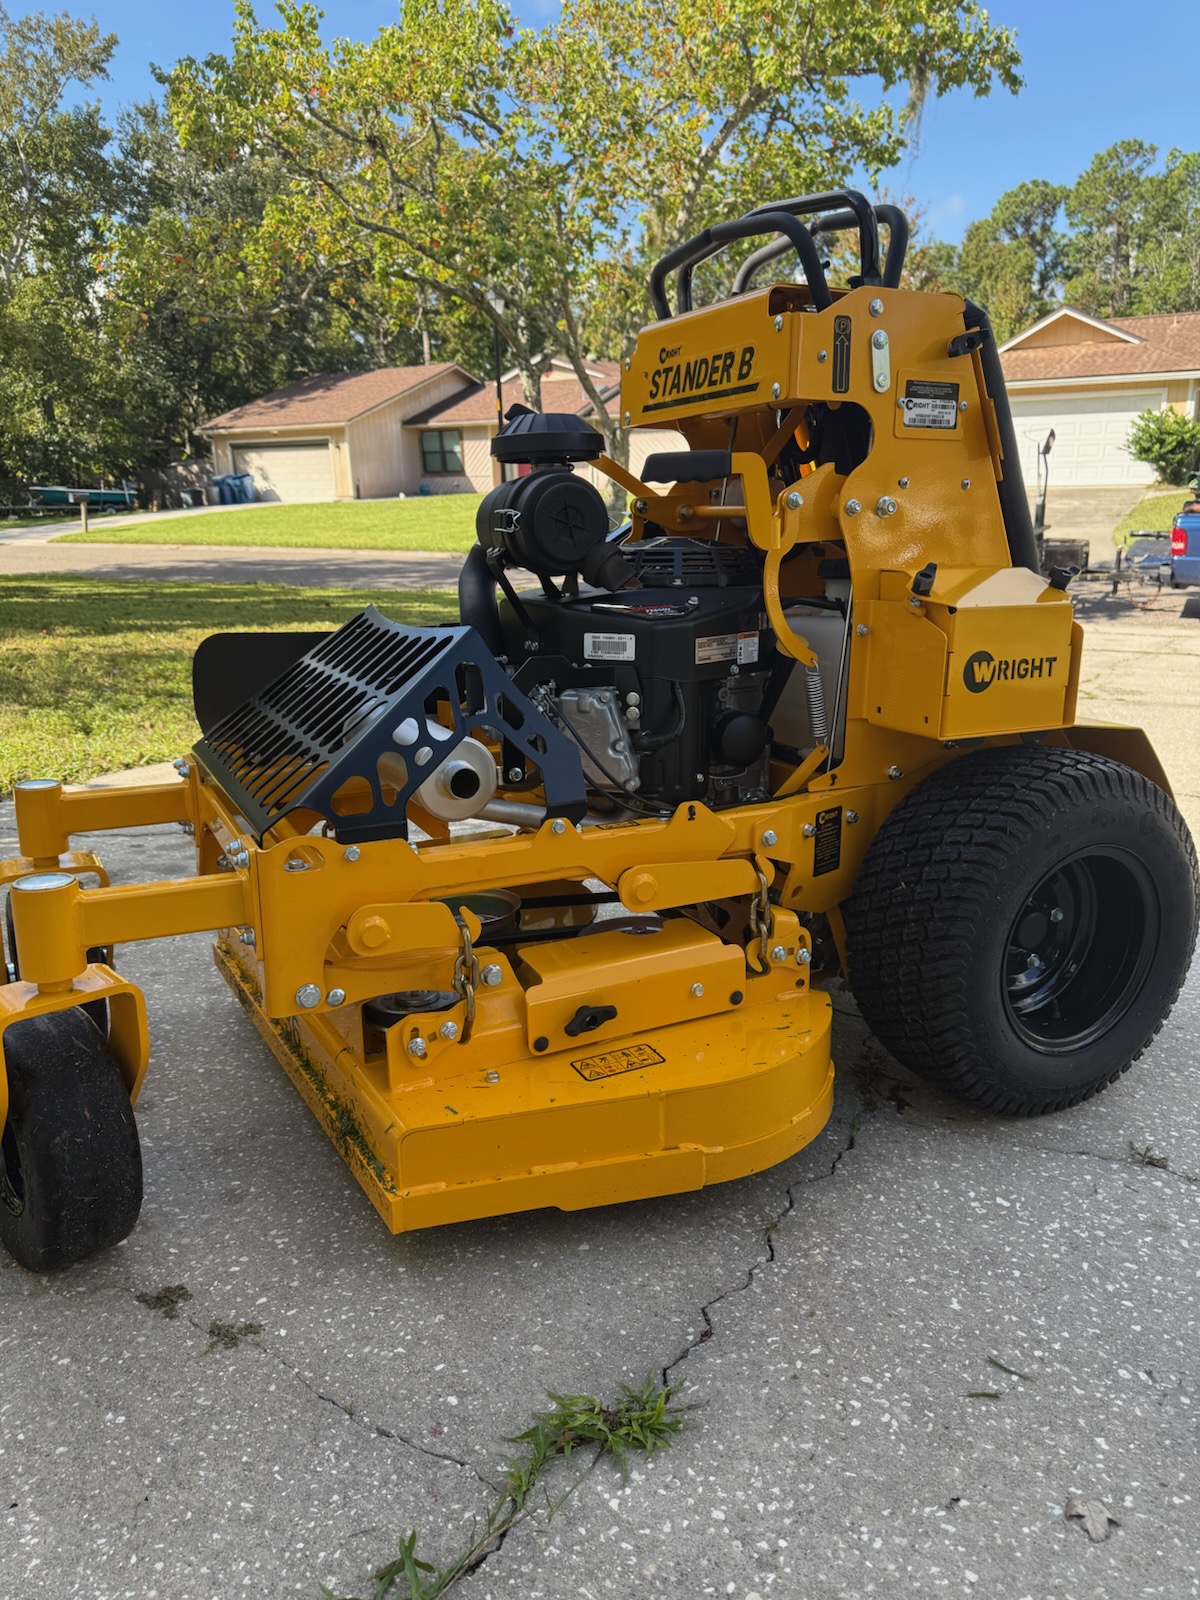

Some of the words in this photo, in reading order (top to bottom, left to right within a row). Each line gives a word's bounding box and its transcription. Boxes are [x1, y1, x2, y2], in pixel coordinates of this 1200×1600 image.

[649, 351, 736, 399] STANDER
[737, 346, 755, 380] B
[905, 399, 931, 411] WRIGHT
[963, 650, 1058, 693] WRIGHT
